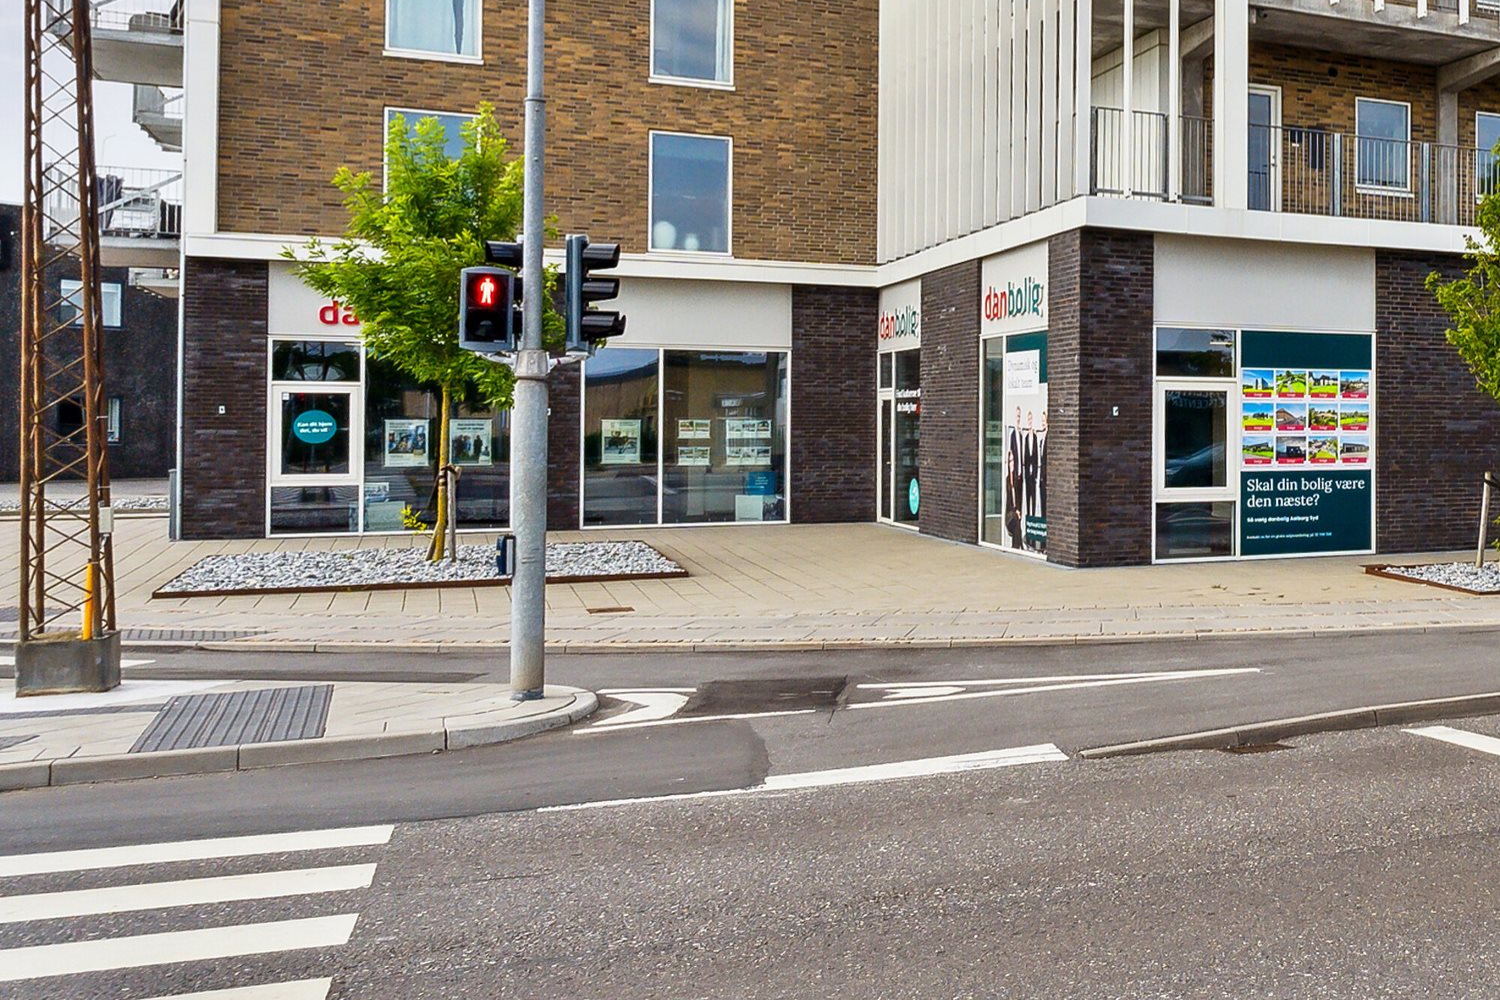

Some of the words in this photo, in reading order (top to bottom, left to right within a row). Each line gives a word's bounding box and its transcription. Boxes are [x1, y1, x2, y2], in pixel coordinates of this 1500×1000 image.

[984, 276, 1043, 320] danbolig
[880, 305, 918, 339] danbolig
[1246, 478, 1274, 492] Skal
[1277, 477, 1298, 491] din
[1300, 477, 1333, 494] bolig
[1335, 479, 1366, 490] være
[1246, 494, 1272, 508] den
[1275, 493, 1320, 507] næste?
